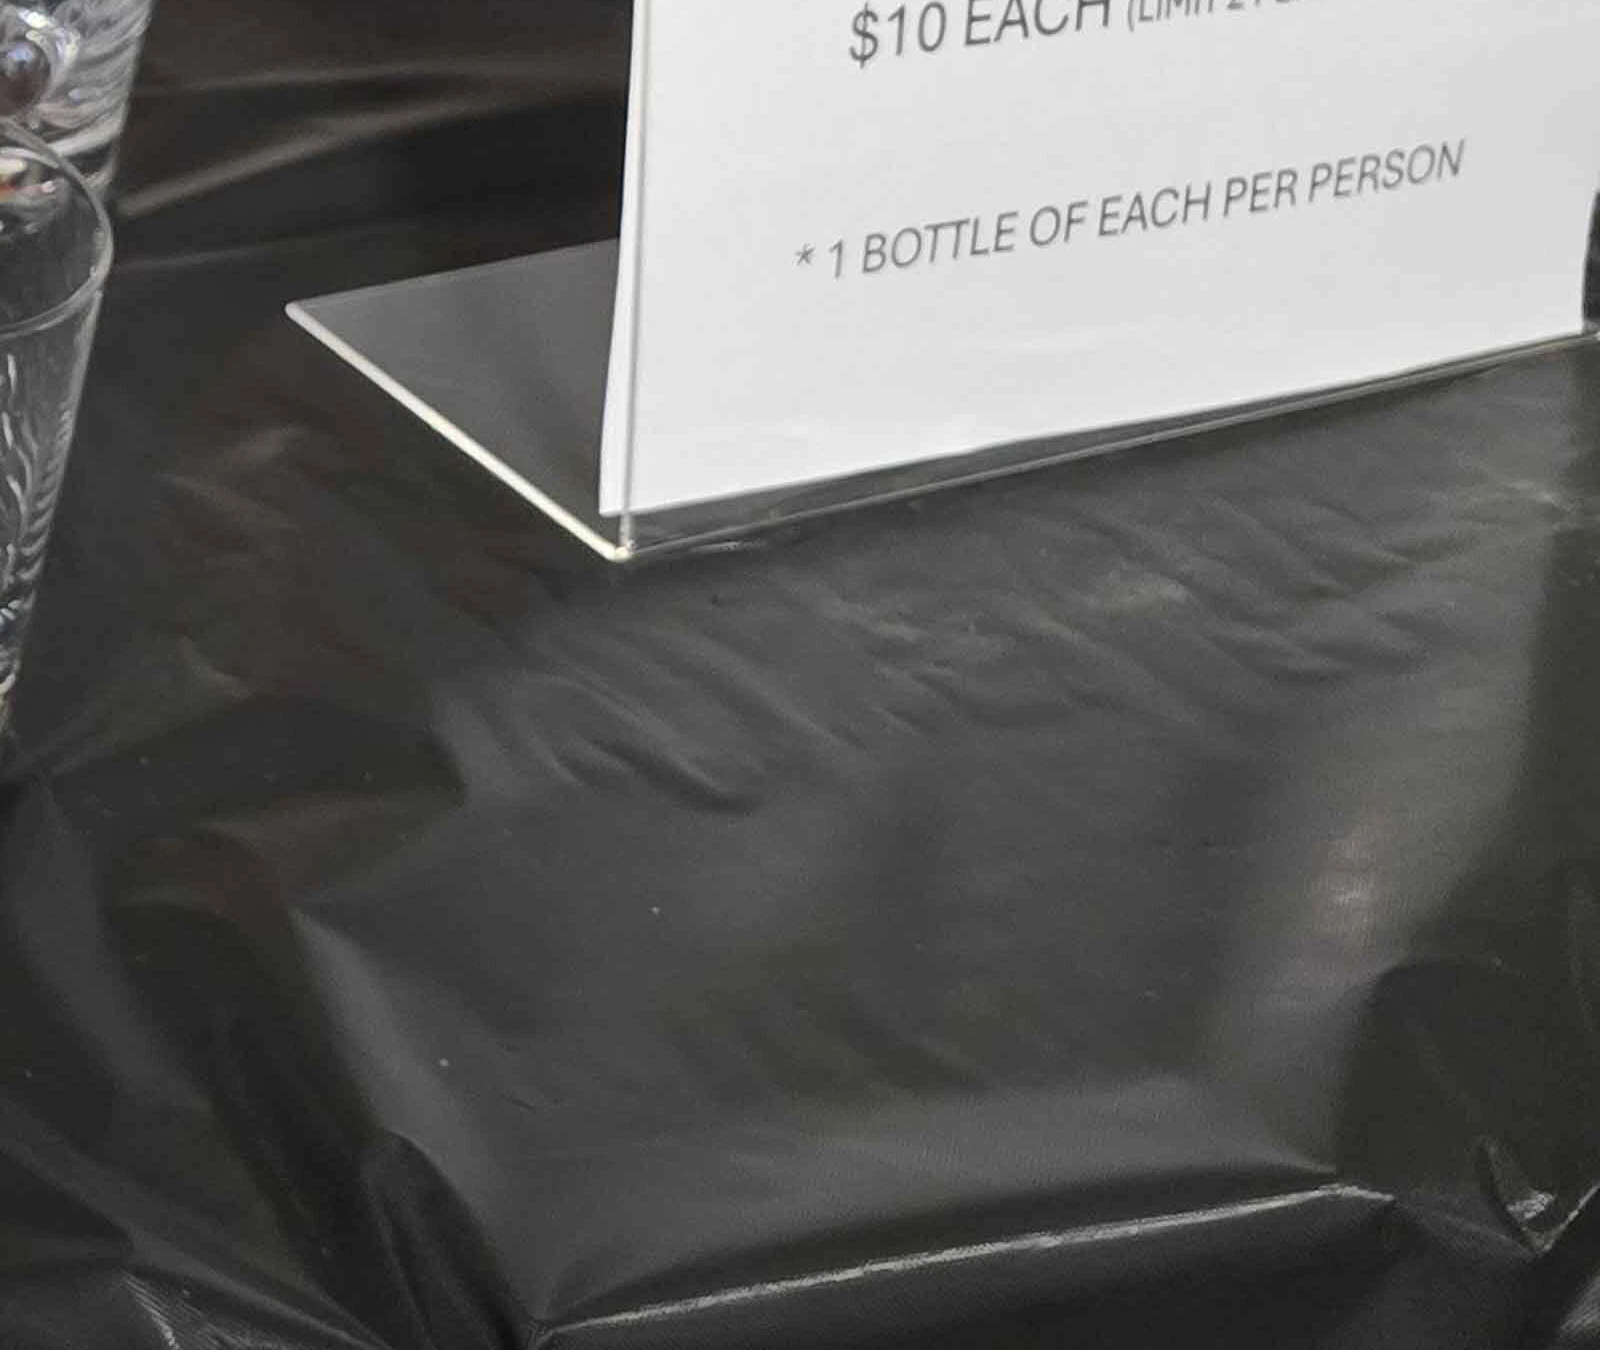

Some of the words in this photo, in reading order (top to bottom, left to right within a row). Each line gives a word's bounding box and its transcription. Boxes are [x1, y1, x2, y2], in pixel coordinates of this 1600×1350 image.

[849, 2, 947, 68] $10
[829, 240, 845, 279] 1
[862, 212, 1018, 273] BOTTLE
[1029, 200, 1087, 247] OF
[1098, 183, 1211, 237] EACH
[1222, 171, 1298, 219] PER
[1308, 140, 1466, 203] PERSON
